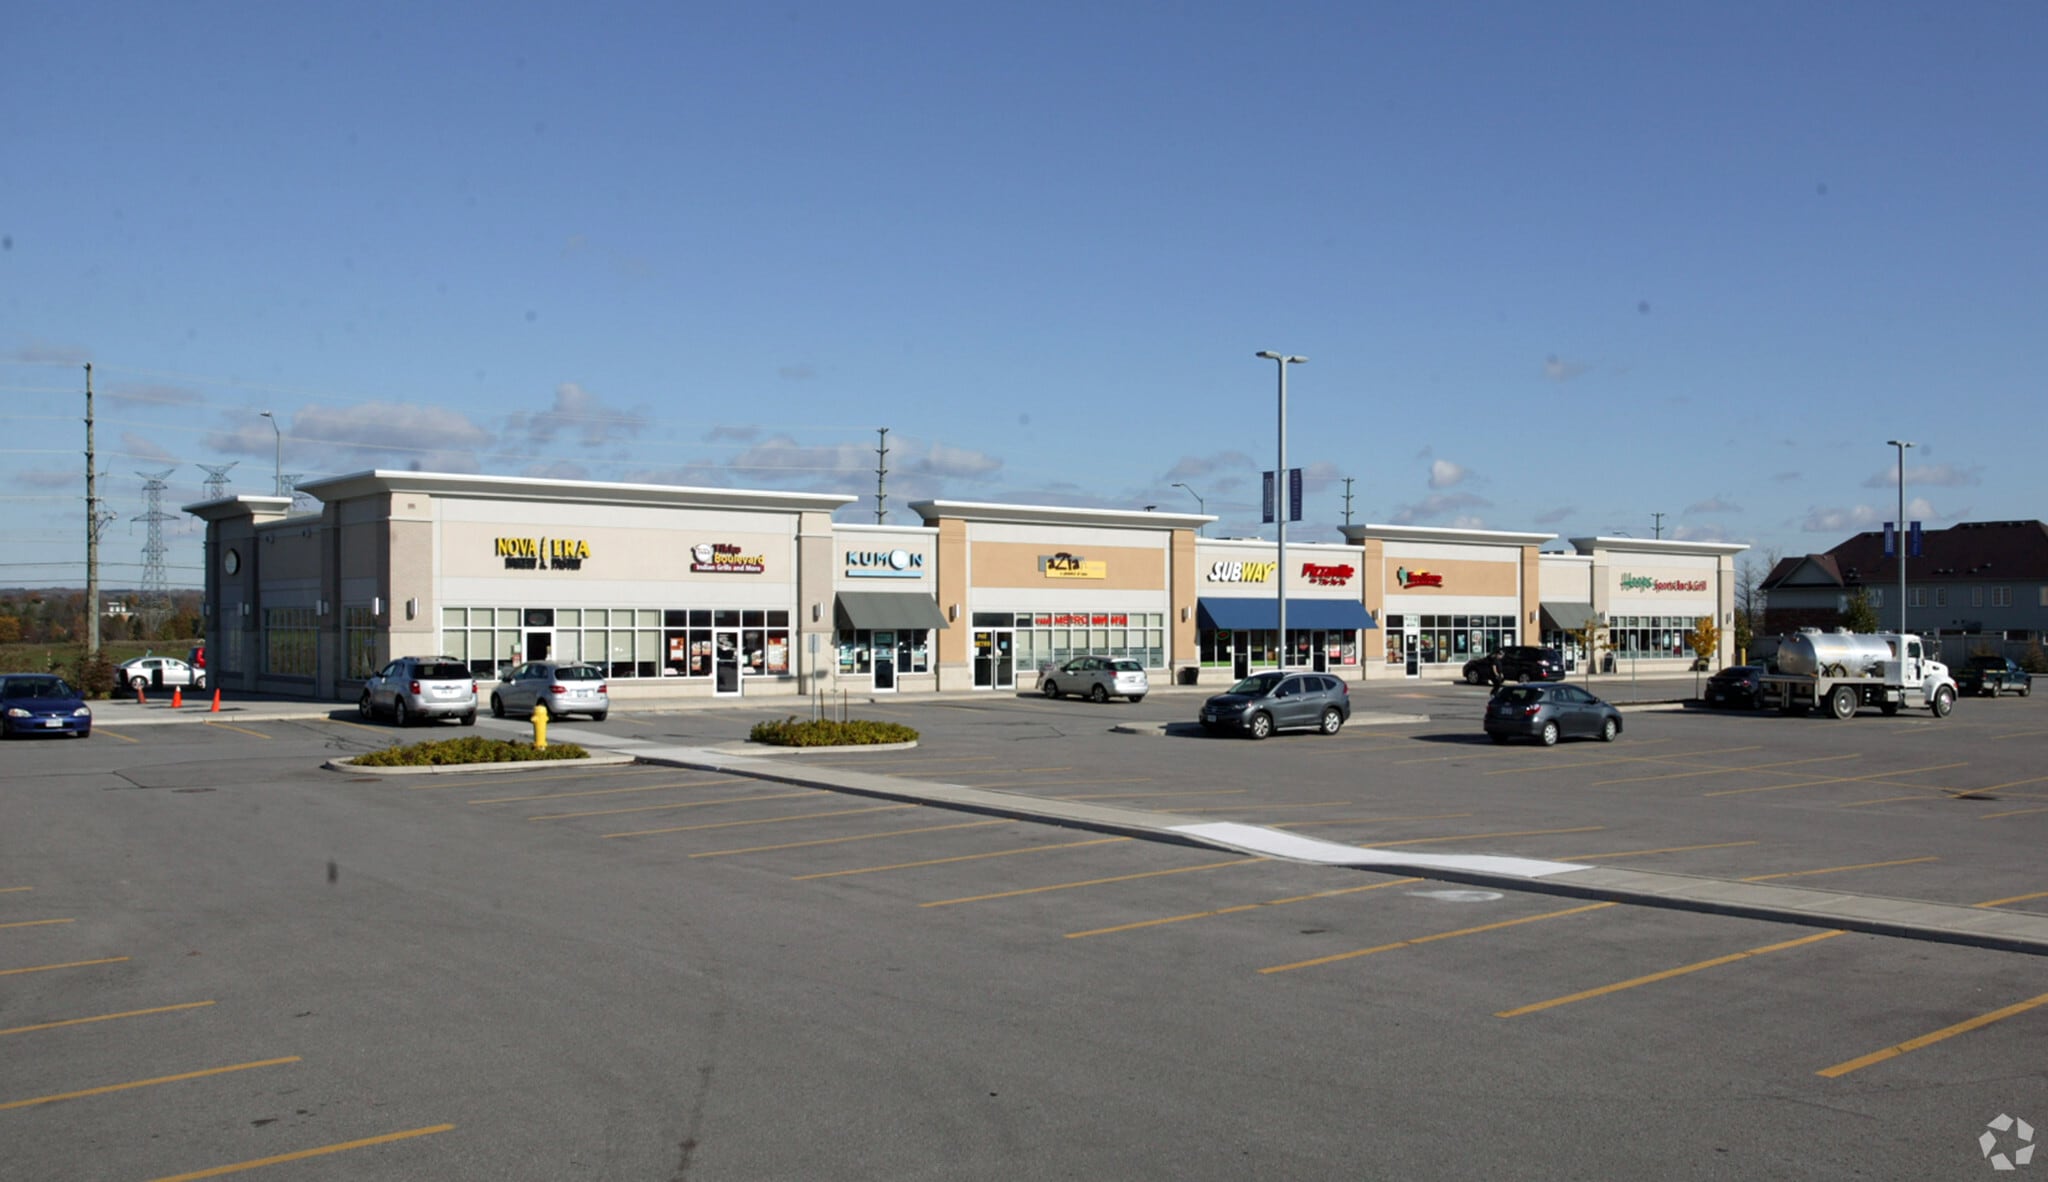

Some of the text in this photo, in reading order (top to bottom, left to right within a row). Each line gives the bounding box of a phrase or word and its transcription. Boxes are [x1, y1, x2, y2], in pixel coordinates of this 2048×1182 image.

[495, 538, 591, 558] NOVA ERA
[713, 553, 765, 566] Boulevard
[846, 549, 924, 570] KUMON
[1207, 561, 1277, 583] SUBWAY
